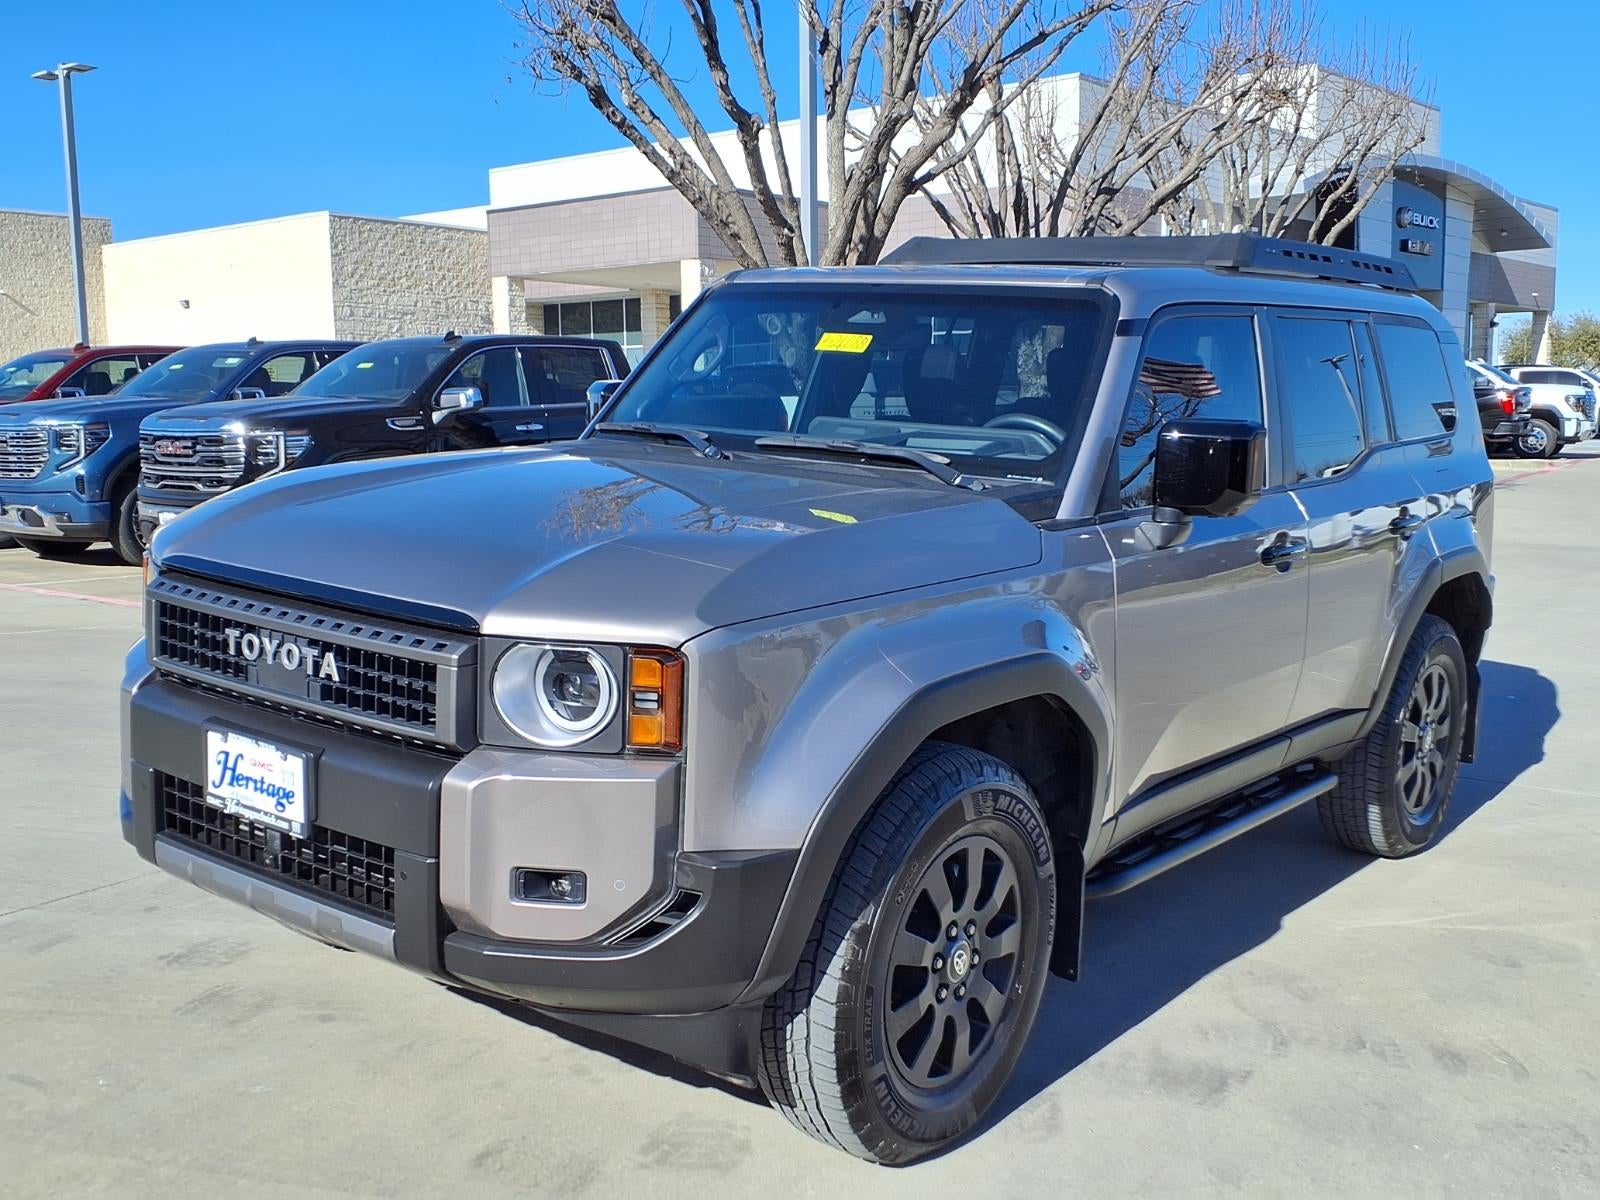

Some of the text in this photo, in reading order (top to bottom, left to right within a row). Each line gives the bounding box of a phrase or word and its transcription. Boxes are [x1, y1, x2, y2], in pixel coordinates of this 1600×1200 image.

[1413, 212, 1440, 229] BUICK
[224, 627, 340, 682] TOYOTA
[212, 750, 295, 813] Heritage
[249, 758, 274, 773] GMC
[996, 794, 1049, 862] MICHELIN
